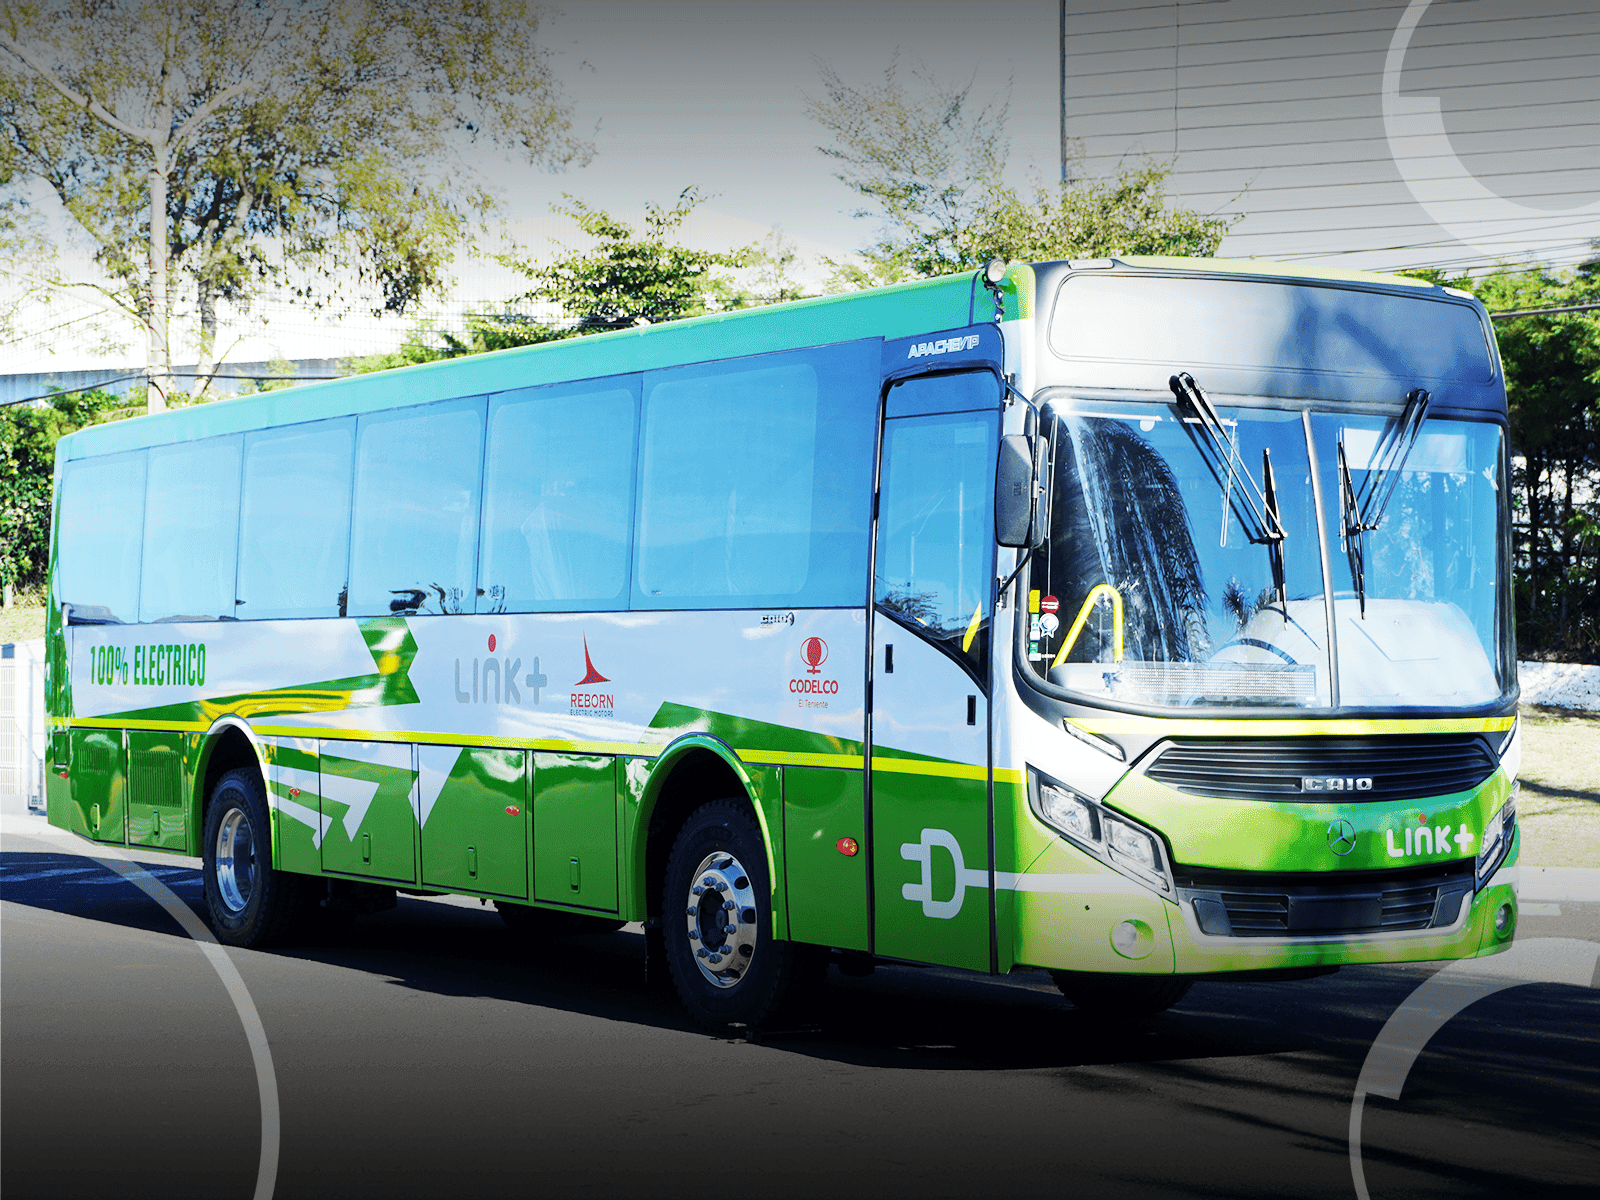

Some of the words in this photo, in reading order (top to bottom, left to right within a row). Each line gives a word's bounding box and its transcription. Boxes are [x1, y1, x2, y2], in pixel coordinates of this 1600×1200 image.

[90, 646, 128, 686] 100%
[134, 643, 206, 687] ELECTRICO
[789, 679, 839, 694] CODELCO
[570, 693, 614, 709] REBORN
[805, 699, 828, 709] Teniente
[1304, 777, 1373, 791] CAIO
